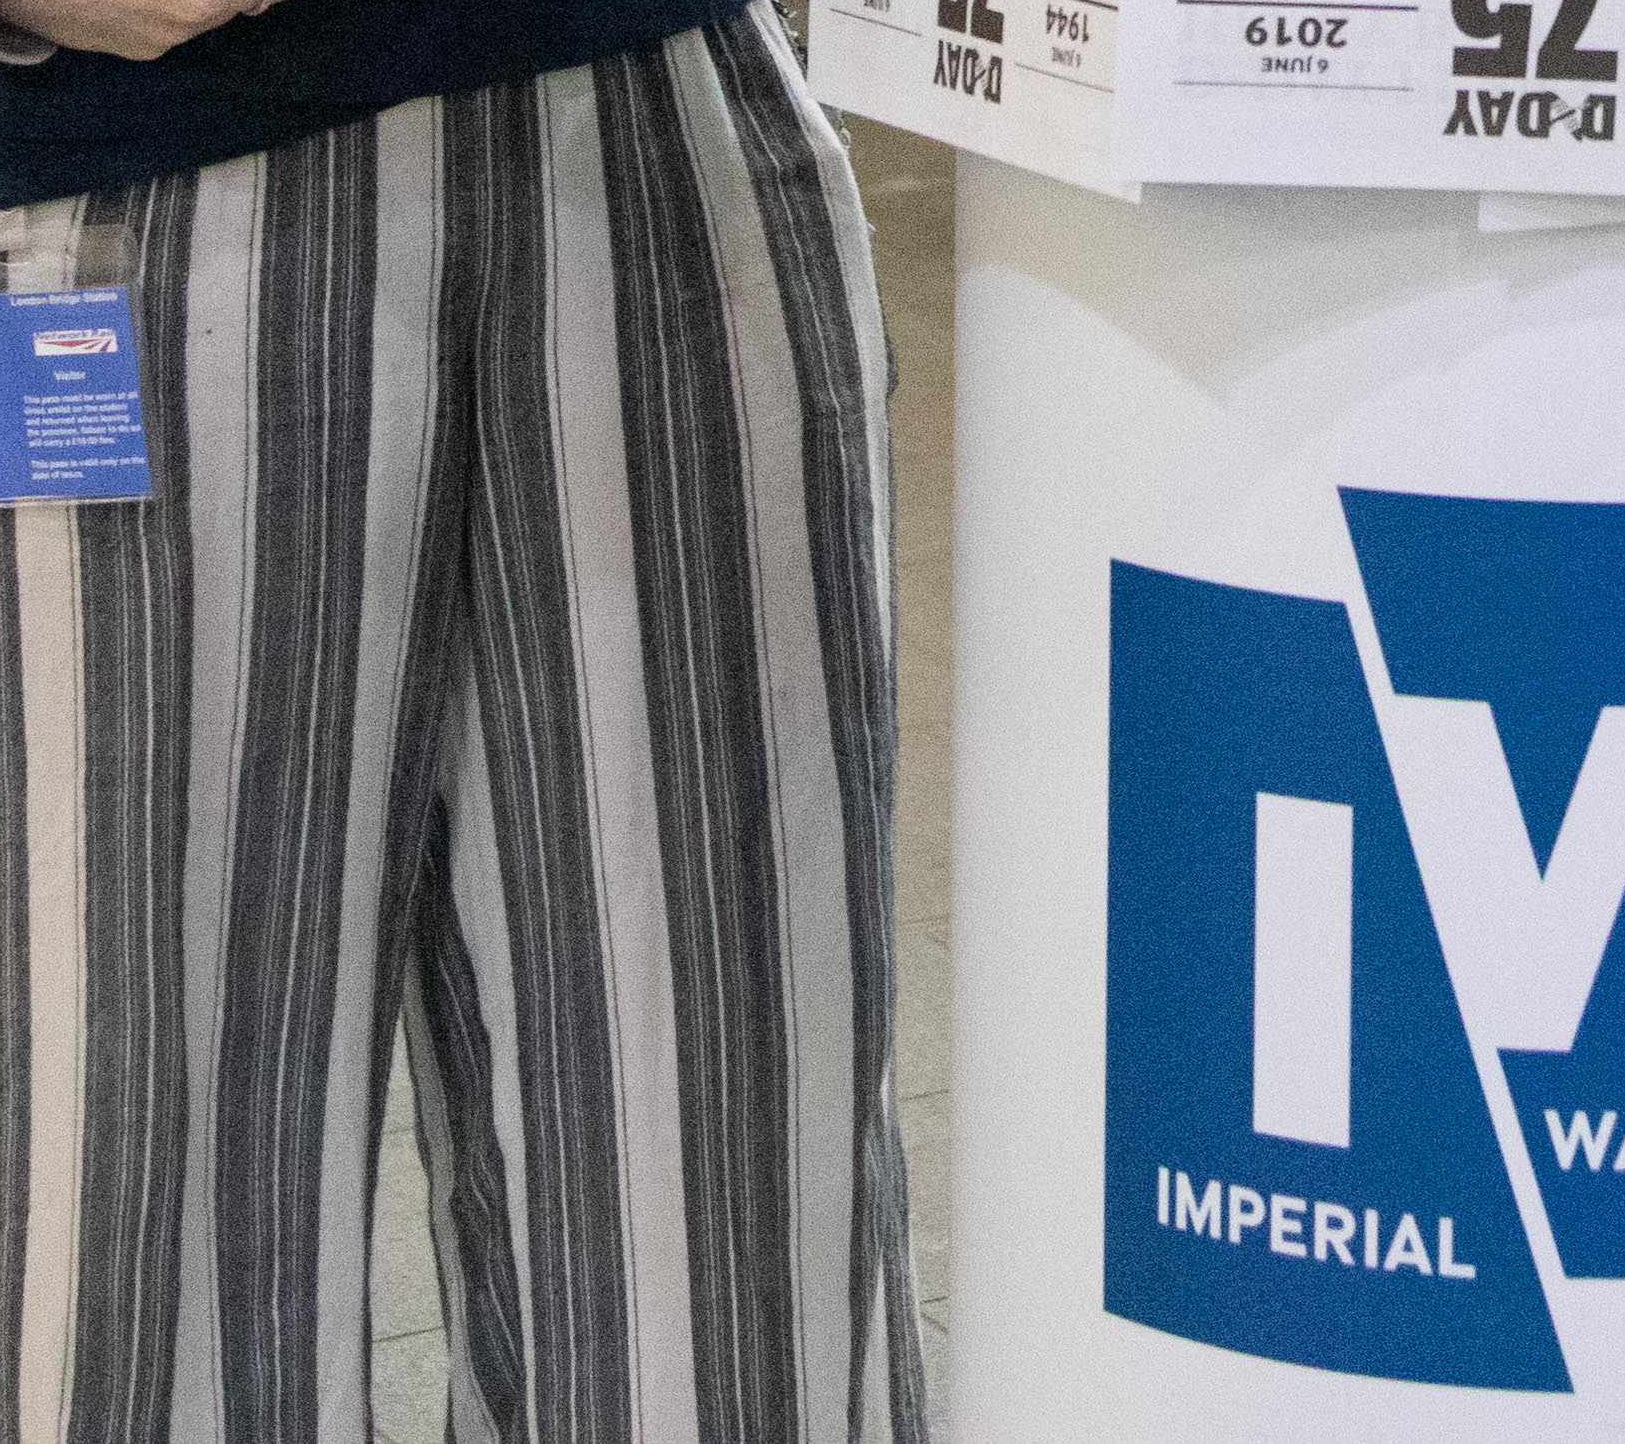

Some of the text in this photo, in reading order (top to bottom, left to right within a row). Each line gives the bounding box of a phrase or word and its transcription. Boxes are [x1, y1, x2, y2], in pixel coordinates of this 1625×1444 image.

[1045, 3, 1090, 43] 1944
[1246, 16, 1349, 49] 2019
[1261, 53, 1329, 74] 6 JUNE
[1156, 1166, 1476, 1280] IMPERIAL
